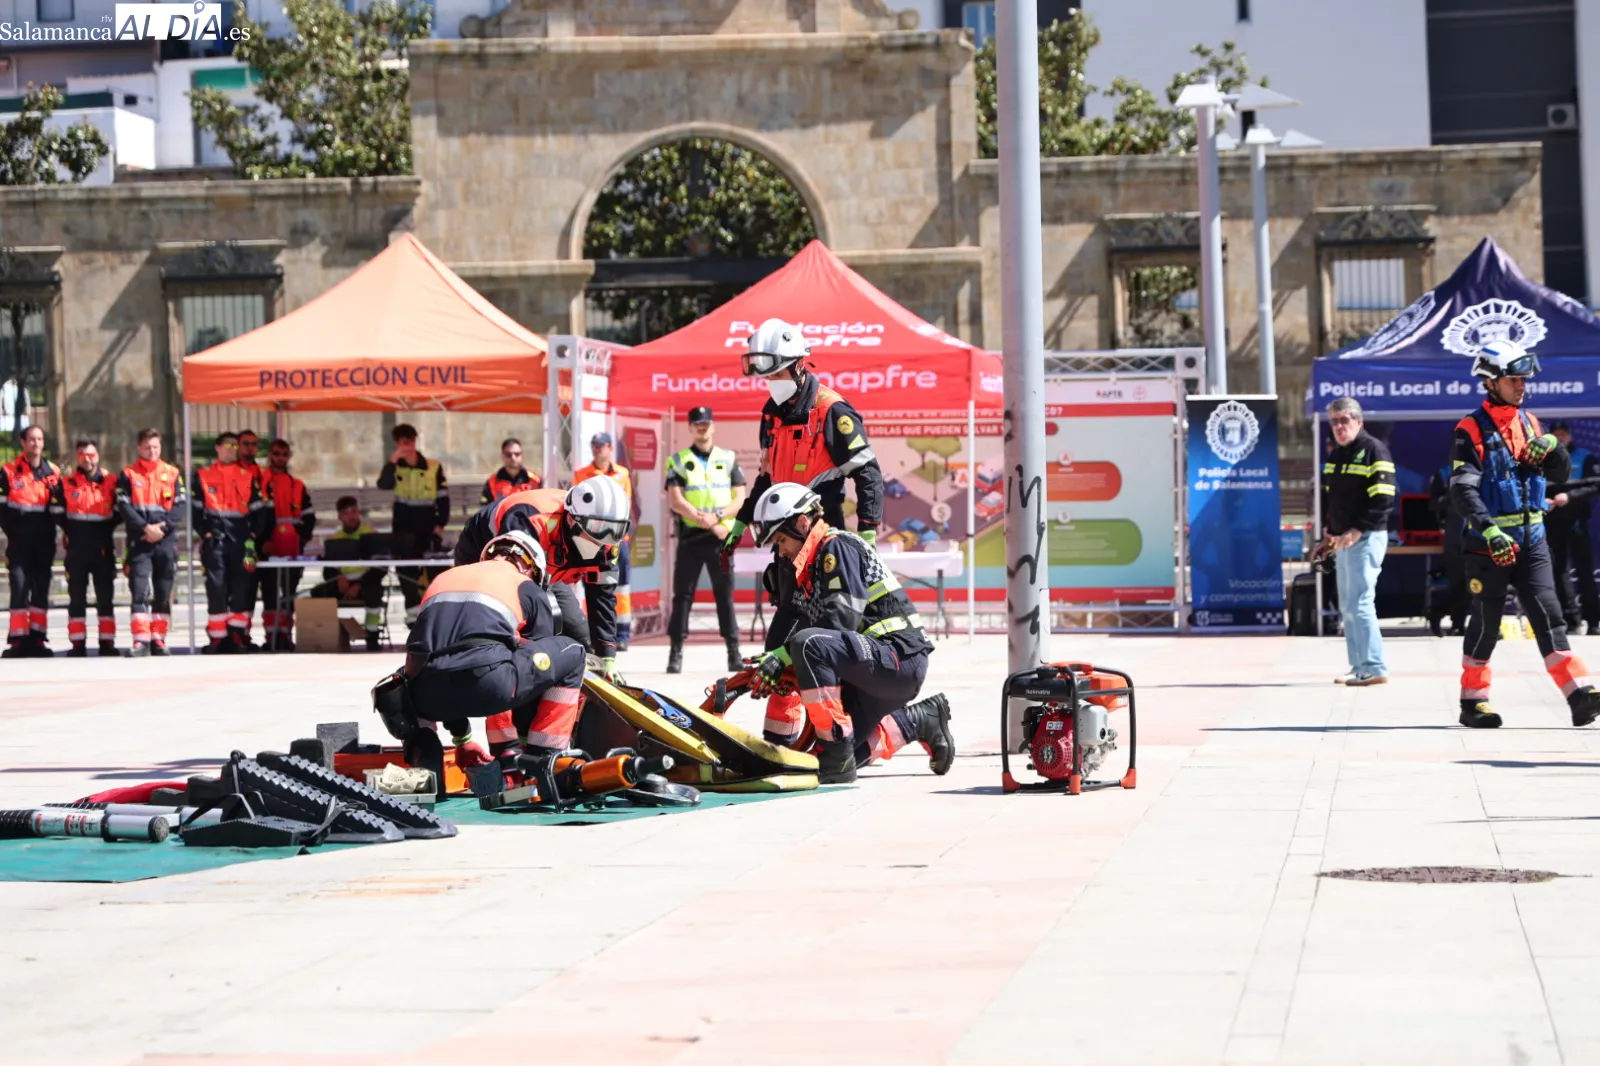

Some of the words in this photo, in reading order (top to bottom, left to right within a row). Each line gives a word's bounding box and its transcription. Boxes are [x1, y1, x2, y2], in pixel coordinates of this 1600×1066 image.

[729, 321, 885, 334] Fuación
[258, 363, 408, 390] PROTECCIÓN
[414, 365, 472, 385] CIVIL
[652, 373, 769, 393] Fundaci
[1320, 380, 1384, 397] Policía
[1390, 380, 1441, 396] Local
[1446, 378, 1471, 395] de
[1476, 380, 1584, 395] Smanca
[868, 425, 901, 435] SIGLAS
[902, 425, 921, 435] QUE
[923, 424, 961, 435] PUEDEN
[962, 424, 999, 435] SLVAR
[1198, 467, 1237, 477] Policía
[1239, 467, 1269, 477] Local
[1194, 480, 1210, 490] de
[1212, 480, 1273, 490] Salamanca
[1229, 579, 1281, 589] Vocación
[1208, 592, 1281, 604] compromiso
